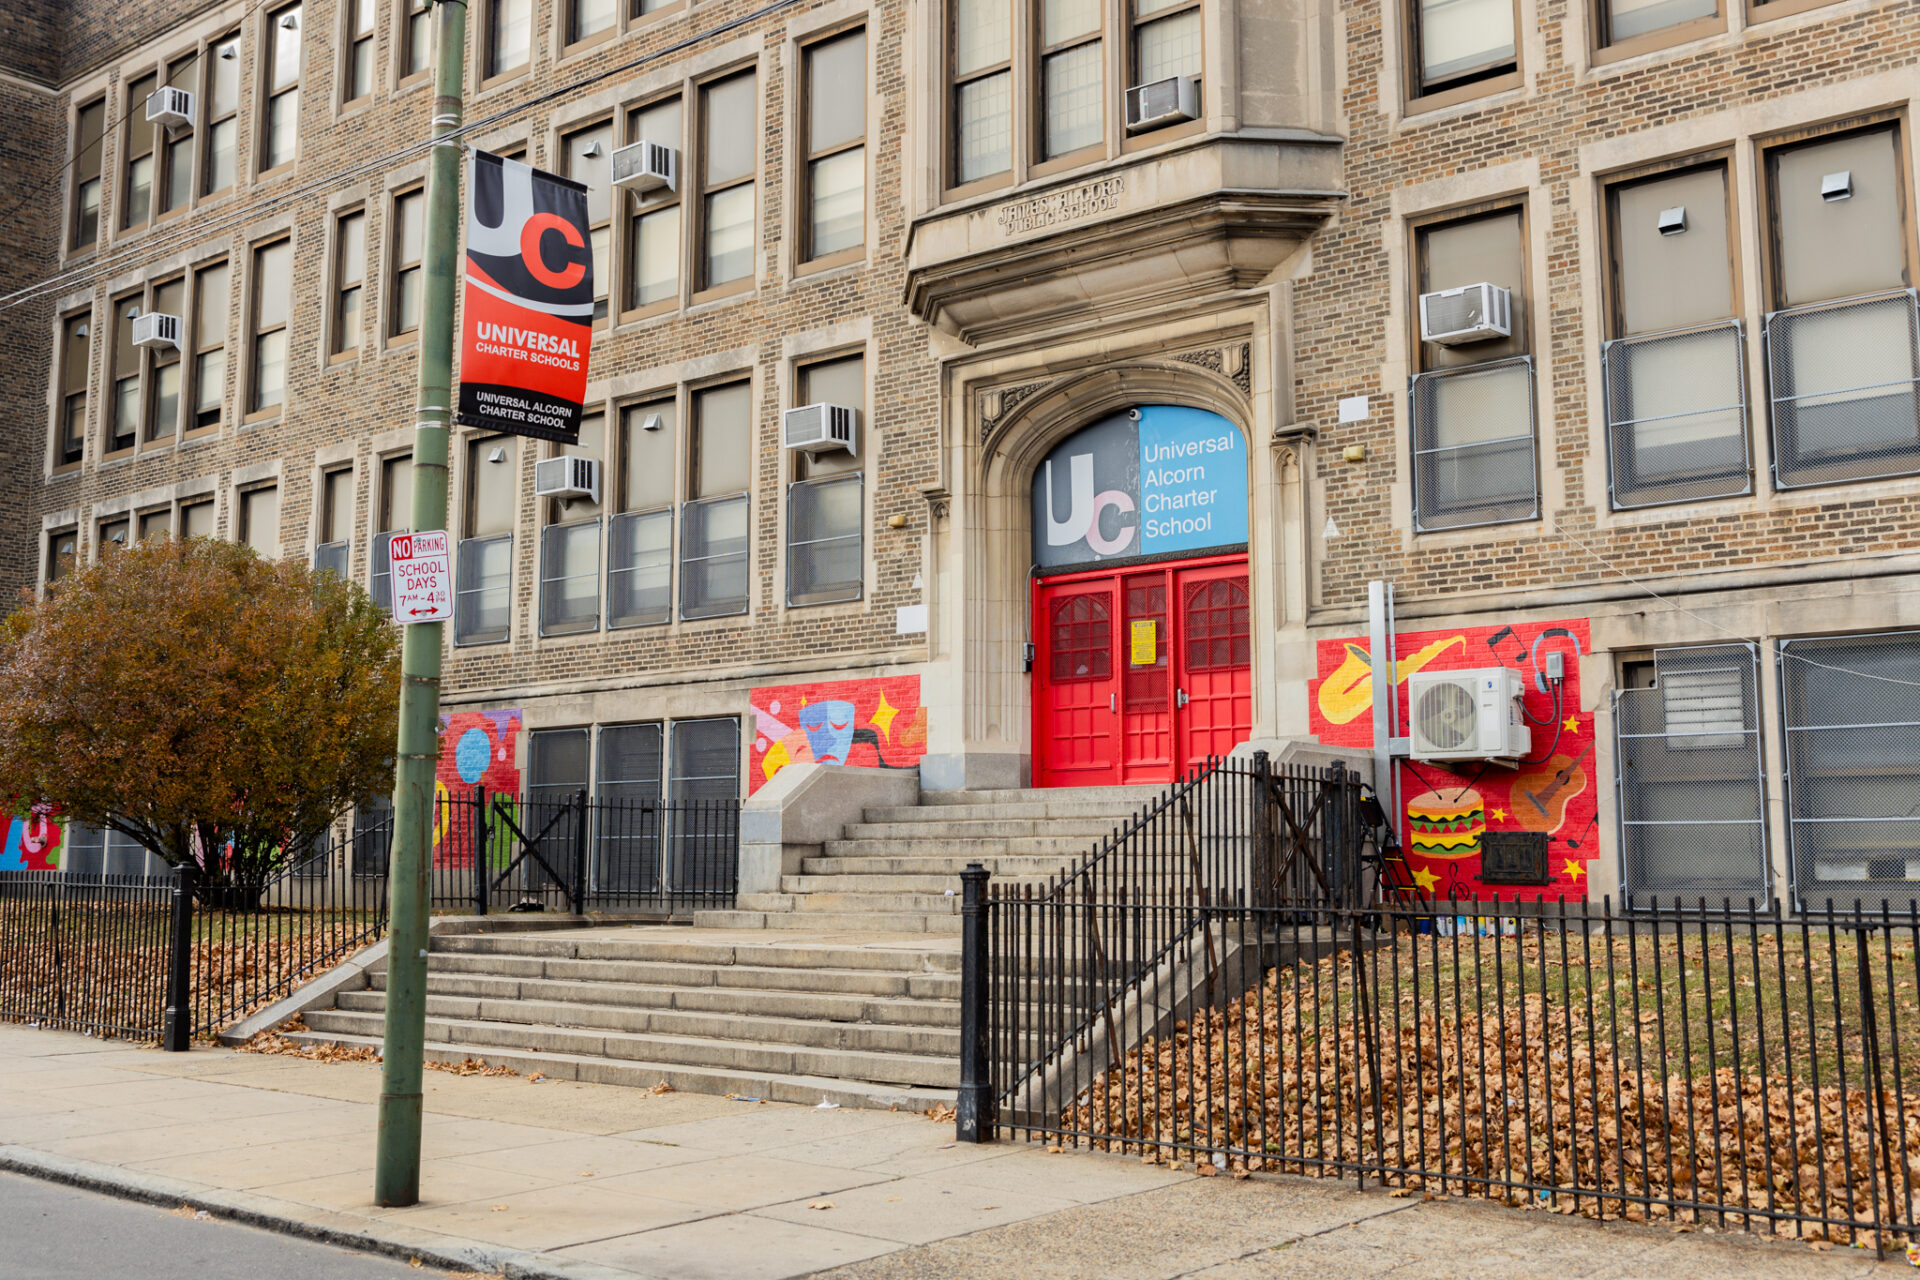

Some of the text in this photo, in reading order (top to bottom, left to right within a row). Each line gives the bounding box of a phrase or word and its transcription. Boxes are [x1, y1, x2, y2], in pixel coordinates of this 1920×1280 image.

[998, 177, 1125, 225] JAMES ALCORN
[1005, 195, 1119, 236] PUBLIC SCHOOL
[476, 320, 580, 358] UNIVERSAL
[475, 342, 580, 371] CHARTER SCHOOLS
[476, 391, 573, 418] UNIVERSAL ALCORN
[479, 404, 566, 429] CHARTER SCHOOL
[1144, 431, 1235, 464] Universal
[1144, 465, 1206, 489] Alcorn
[1145, 489, 1218, 514] Charter
[1145, 512, 1212, 539] School
[393, 536, 445, 559] NO PARKING
[398, 561, 446, 578] SCHOOL
[407, 576, 437, 591] DAYS
